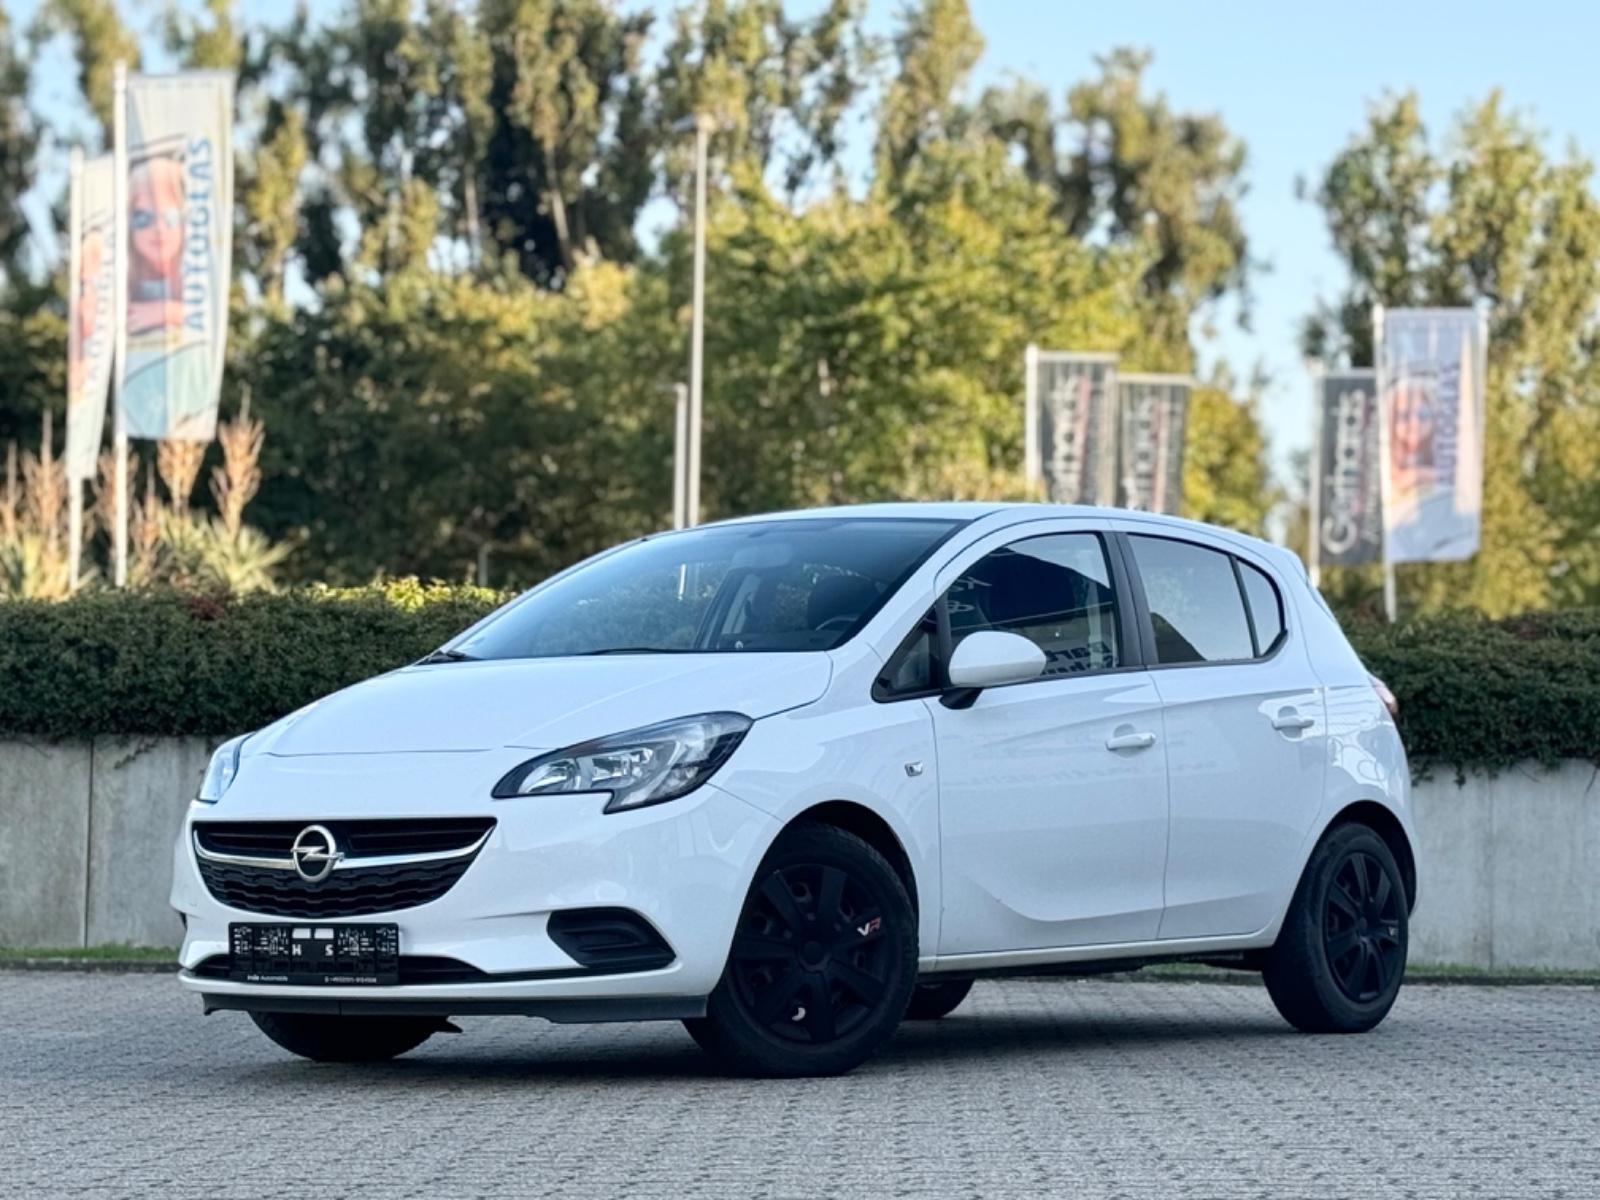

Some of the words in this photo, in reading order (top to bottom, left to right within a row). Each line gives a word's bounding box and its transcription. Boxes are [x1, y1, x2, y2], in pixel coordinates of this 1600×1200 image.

[184, 136, 212, 332] AUTOGLAS
[292, 944, 302, 956] H
[325, 944, 334, 956] S
